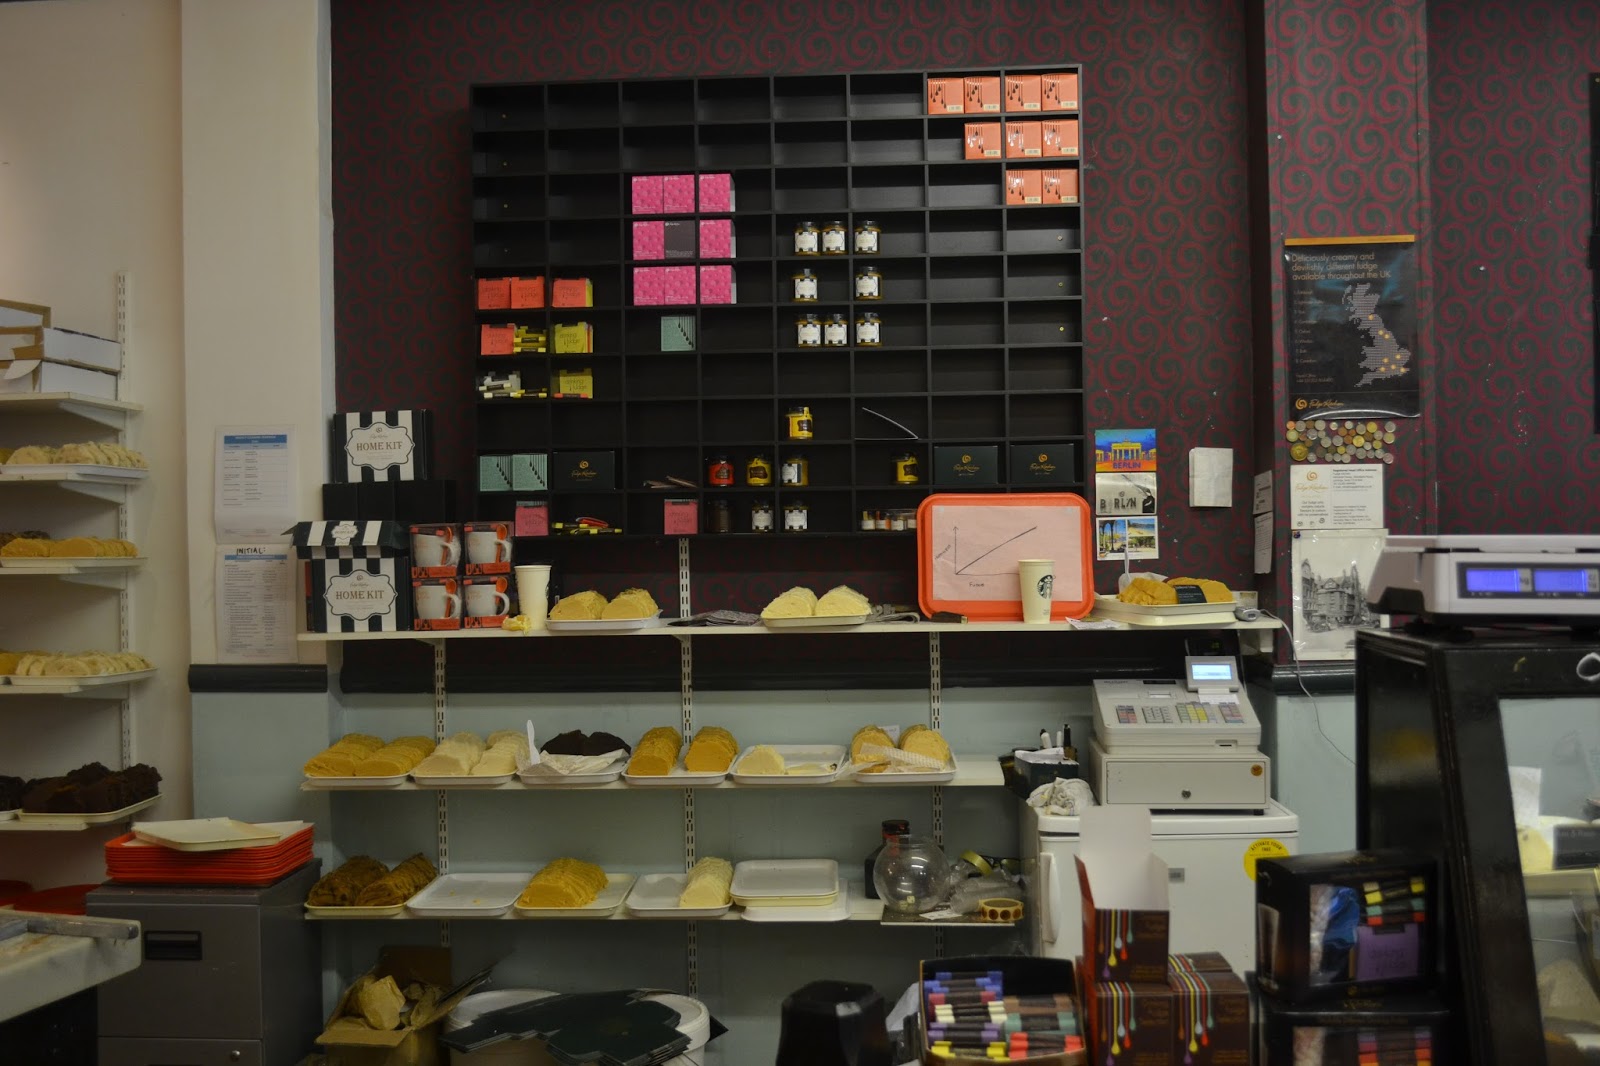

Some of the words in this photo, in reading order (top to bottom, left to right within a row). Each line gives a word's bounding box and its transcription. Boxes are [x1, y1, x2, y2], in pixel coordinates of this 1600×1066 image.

[1292, 253, 1329, 262] Deliciously
[1332, 254, 1358, 262] creamy
[1360, 252, 1374, 260] and
[1292, 263, 1324, 272] devilishly
[1356, 262, 1378, 271] fudge
[1292, 272, 1326, 280] available
[1327, 272, 1365, 281] throughout
[356, 442, 384, 451] HOME
[386, 442, 403, 450] KIT
[336, 590, 365, 600] HOME
[367, 590, 384, 599] KIT
[1251, 841, 1269, 851] ACTIVATE
[1270, 842, 1282, 850] YOUR
